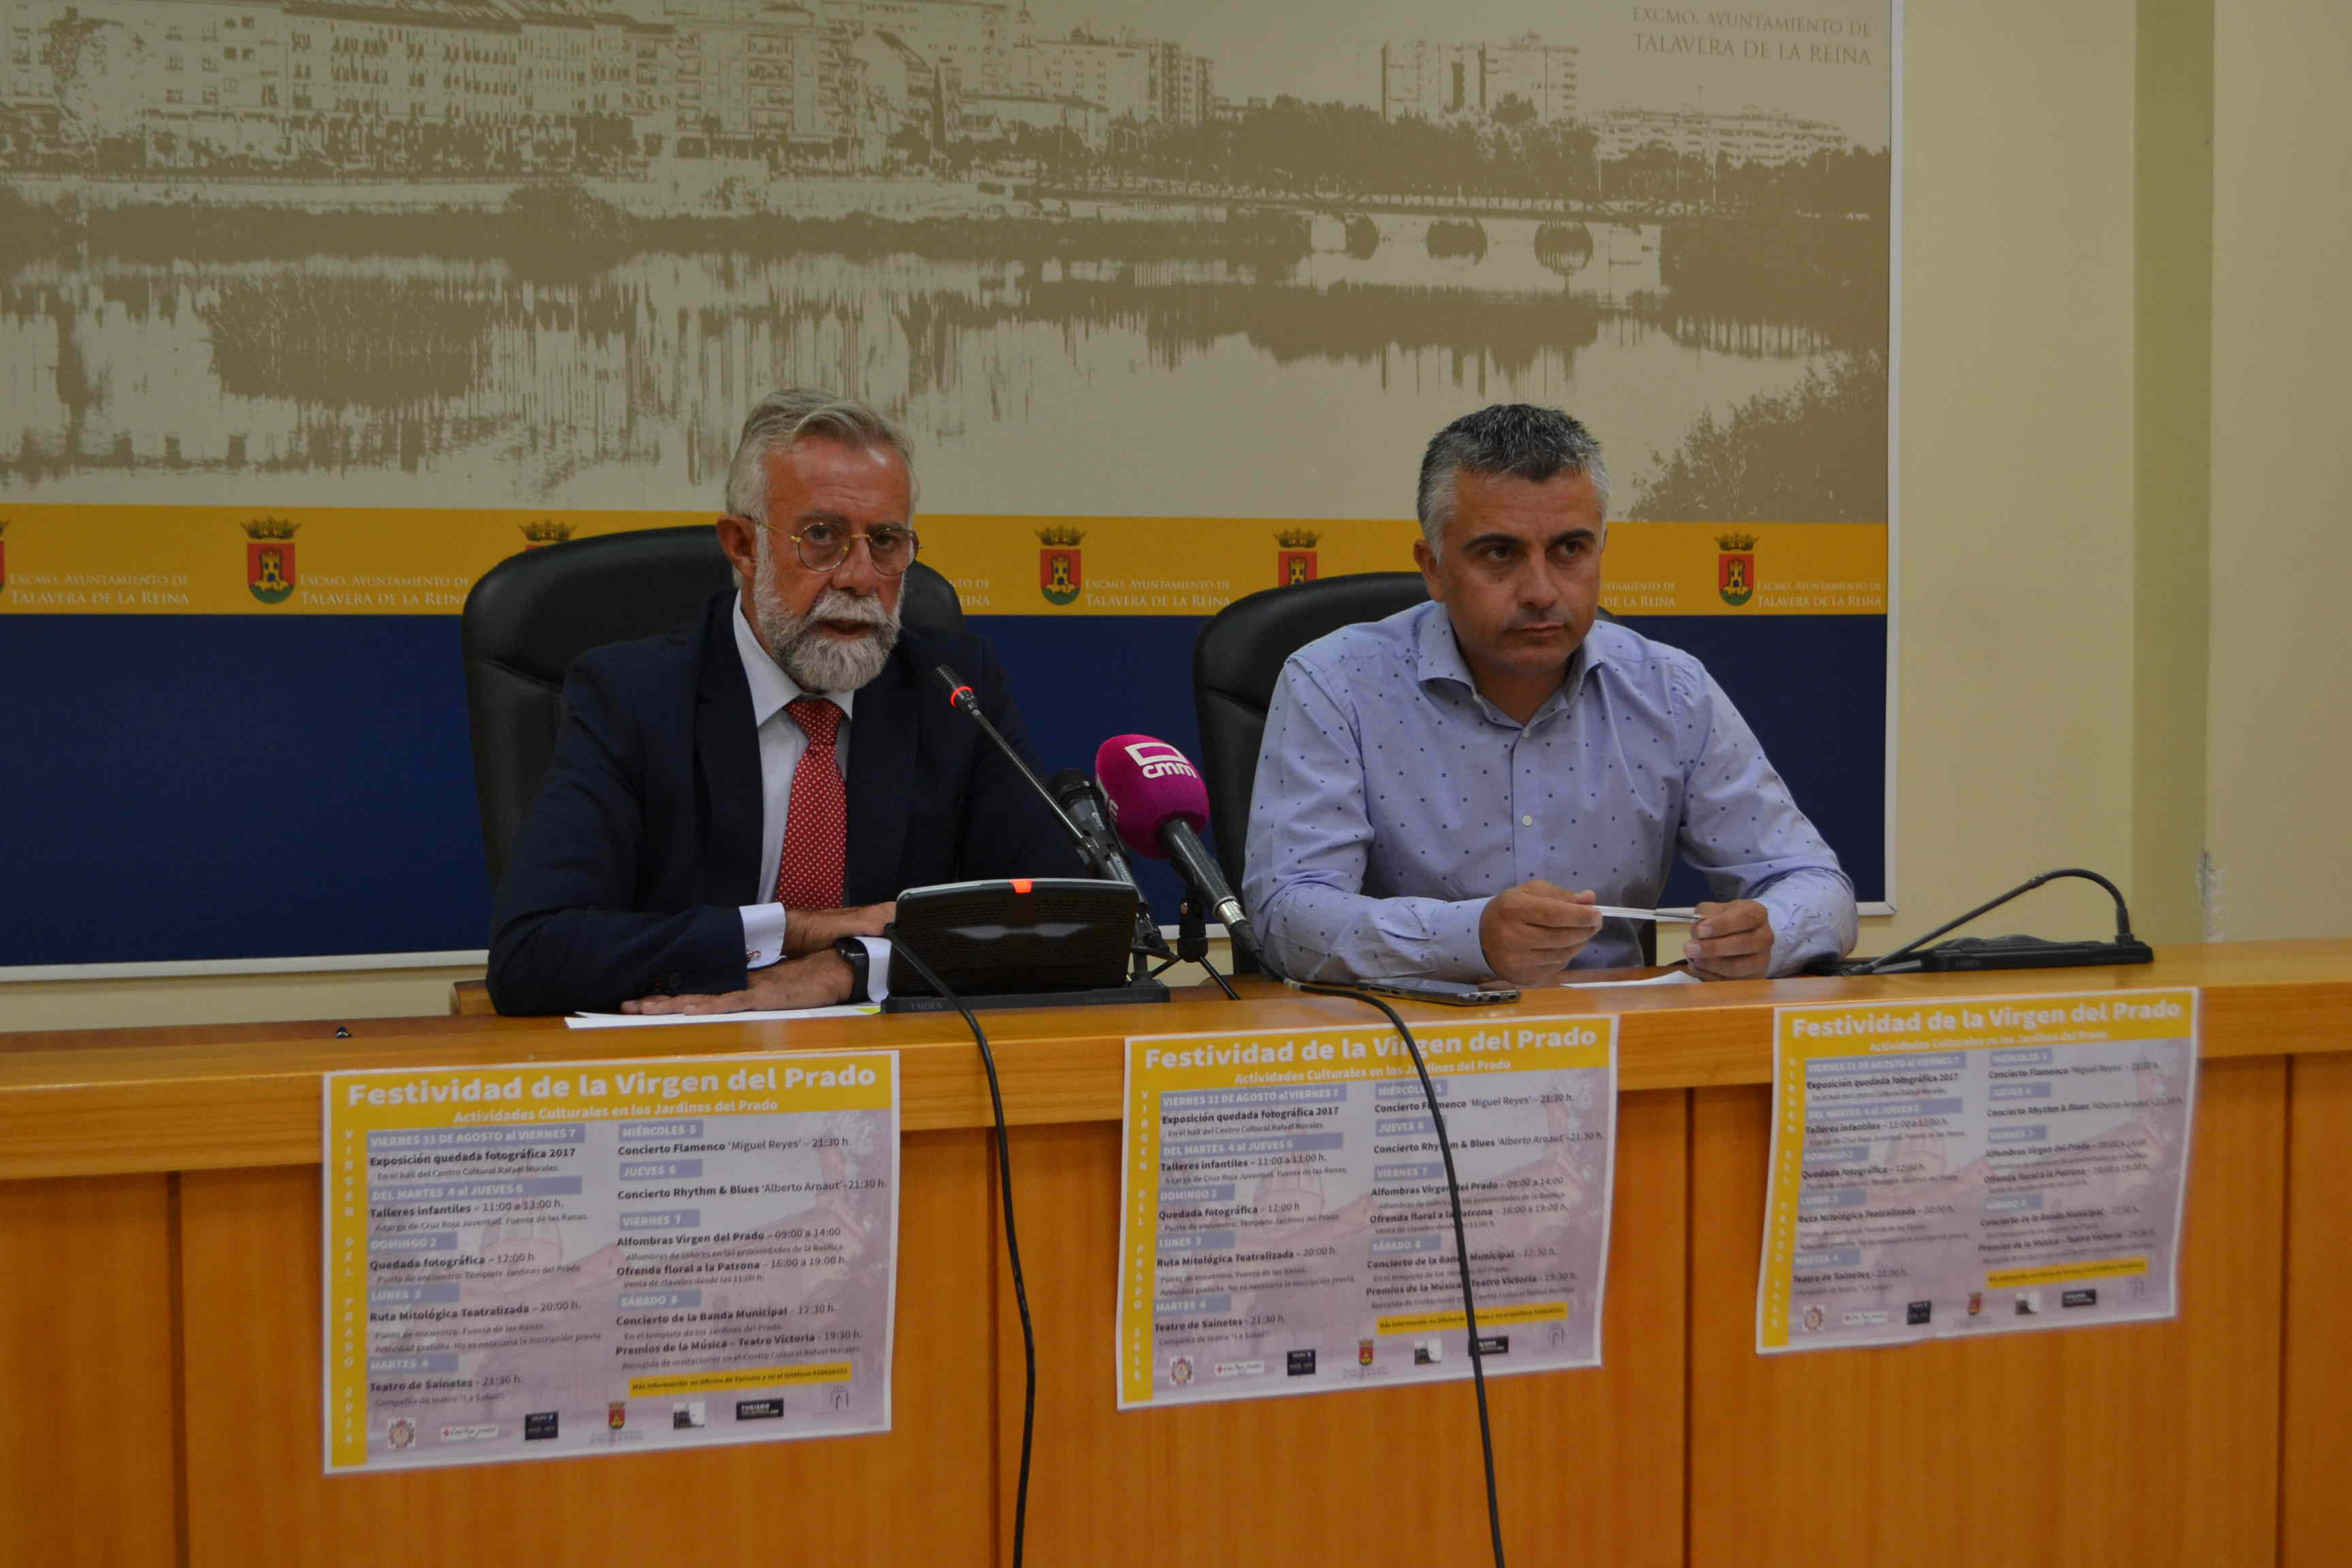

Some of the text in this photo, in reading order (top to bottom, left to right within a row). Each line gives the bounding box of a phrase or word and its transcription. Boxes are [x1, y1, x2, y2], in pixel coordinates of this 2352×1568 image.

[1633, 6, 1871, 38] EXCMO. AYUNTAMIENTO DE
[1633, 33, 1872, 65] TALAVERA DE LA REINA
[1142, 762, 1198, 779] cmm
[1791, 998, 2181, 1038] Festividad de la Virgen del Prado
[1145, 1040, 1294, 1069] Festividad
[1301, 1038, 1335, 1062] de
[1340, 1036, 1367, 1060] la
[1469, 1029, 1512, 1052] del
[1517, 1025, 1597, 1050] Prado
[348, 1062, 877, 1107] Festividad de la Virgen del Prado
[453, 1098, 779, 1124] Actividades Culturales en los Jardines del Prado
[370, 1146, 576, 1169] Exposición quedada fotográfica 2017
[617, 1143, 670, 1158] Concierto
[673, 1141, 725, 1156] Flamenco
[811, 1135, 840, 1148] 21:30
[841, 1134, 852, 1147] h.
[370, 1252, 534, 1273] Quedada fotográfica 12:00 h
